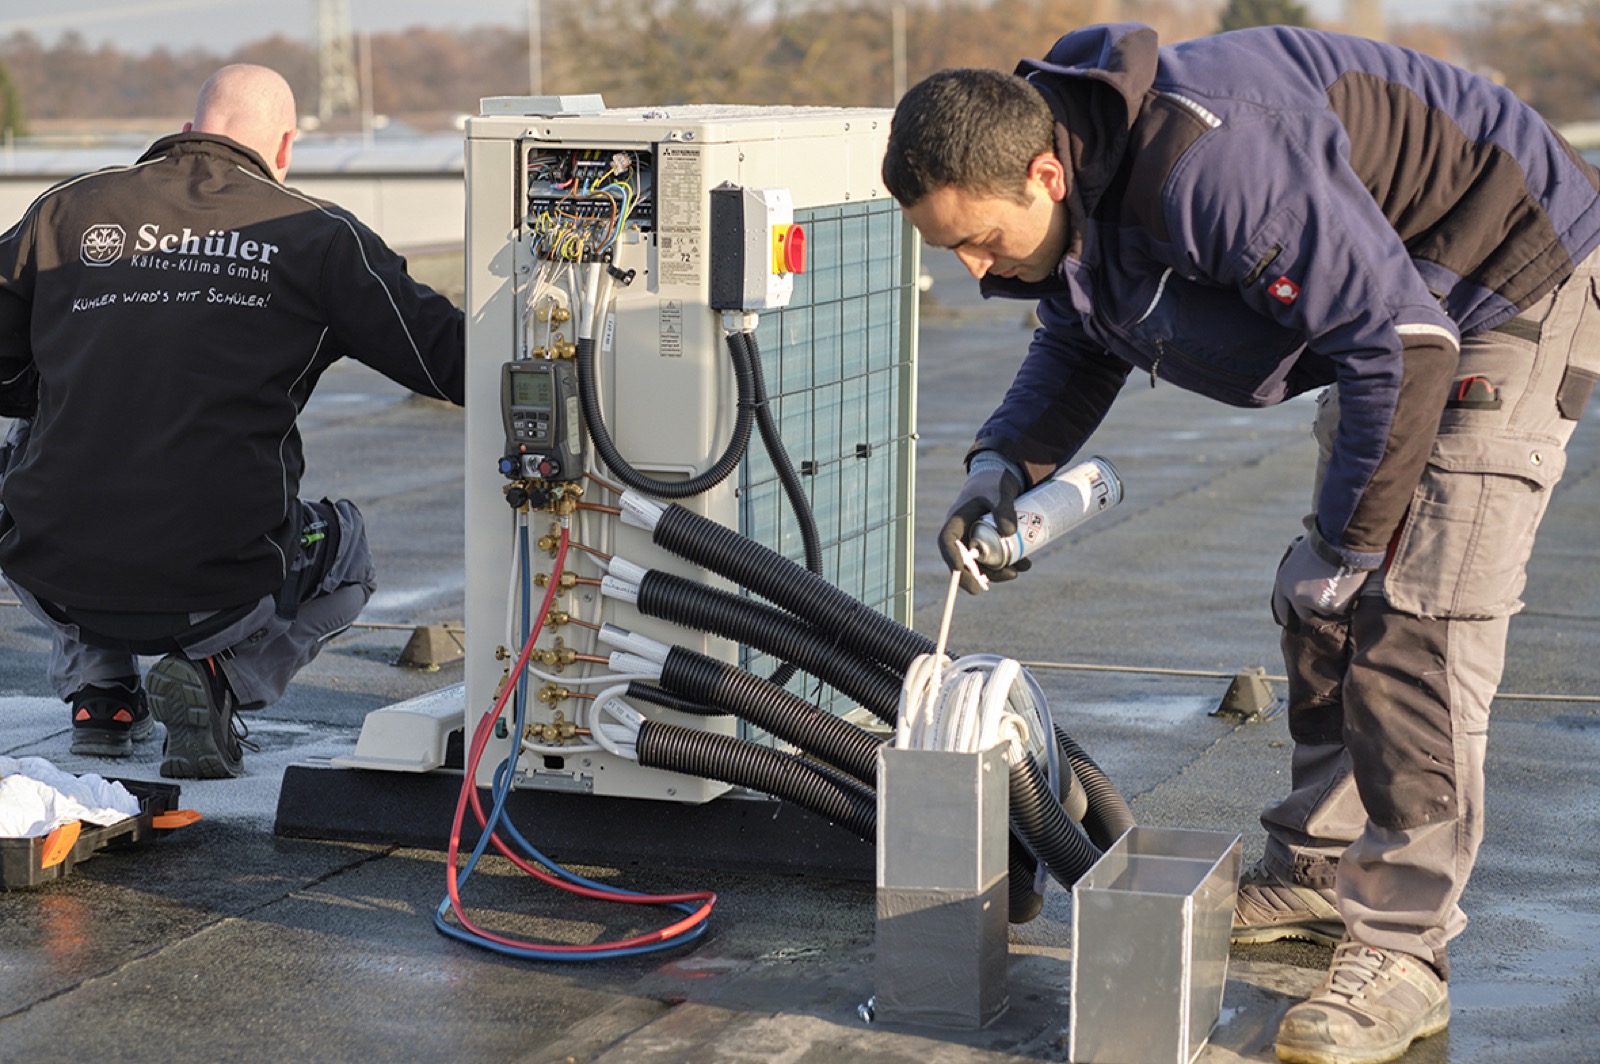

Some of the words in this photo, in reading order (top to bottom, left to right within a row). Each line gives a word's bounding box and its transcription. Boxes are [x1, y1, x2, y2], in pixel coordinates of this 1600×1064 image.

[134, 222, 279, 265] Schüler
[681, 252, 691, 262] 72
[131, 254, 221, 275] Kälte-Klima
[227, 262, 270, 282] GmbH
[72, 292, 118, 313] KÜHLER
[122, 289, 169, 303] WIRD'S
[175, 290, 201, 302] MIT
[206, 287, 272, 309] SCHÜLER!
